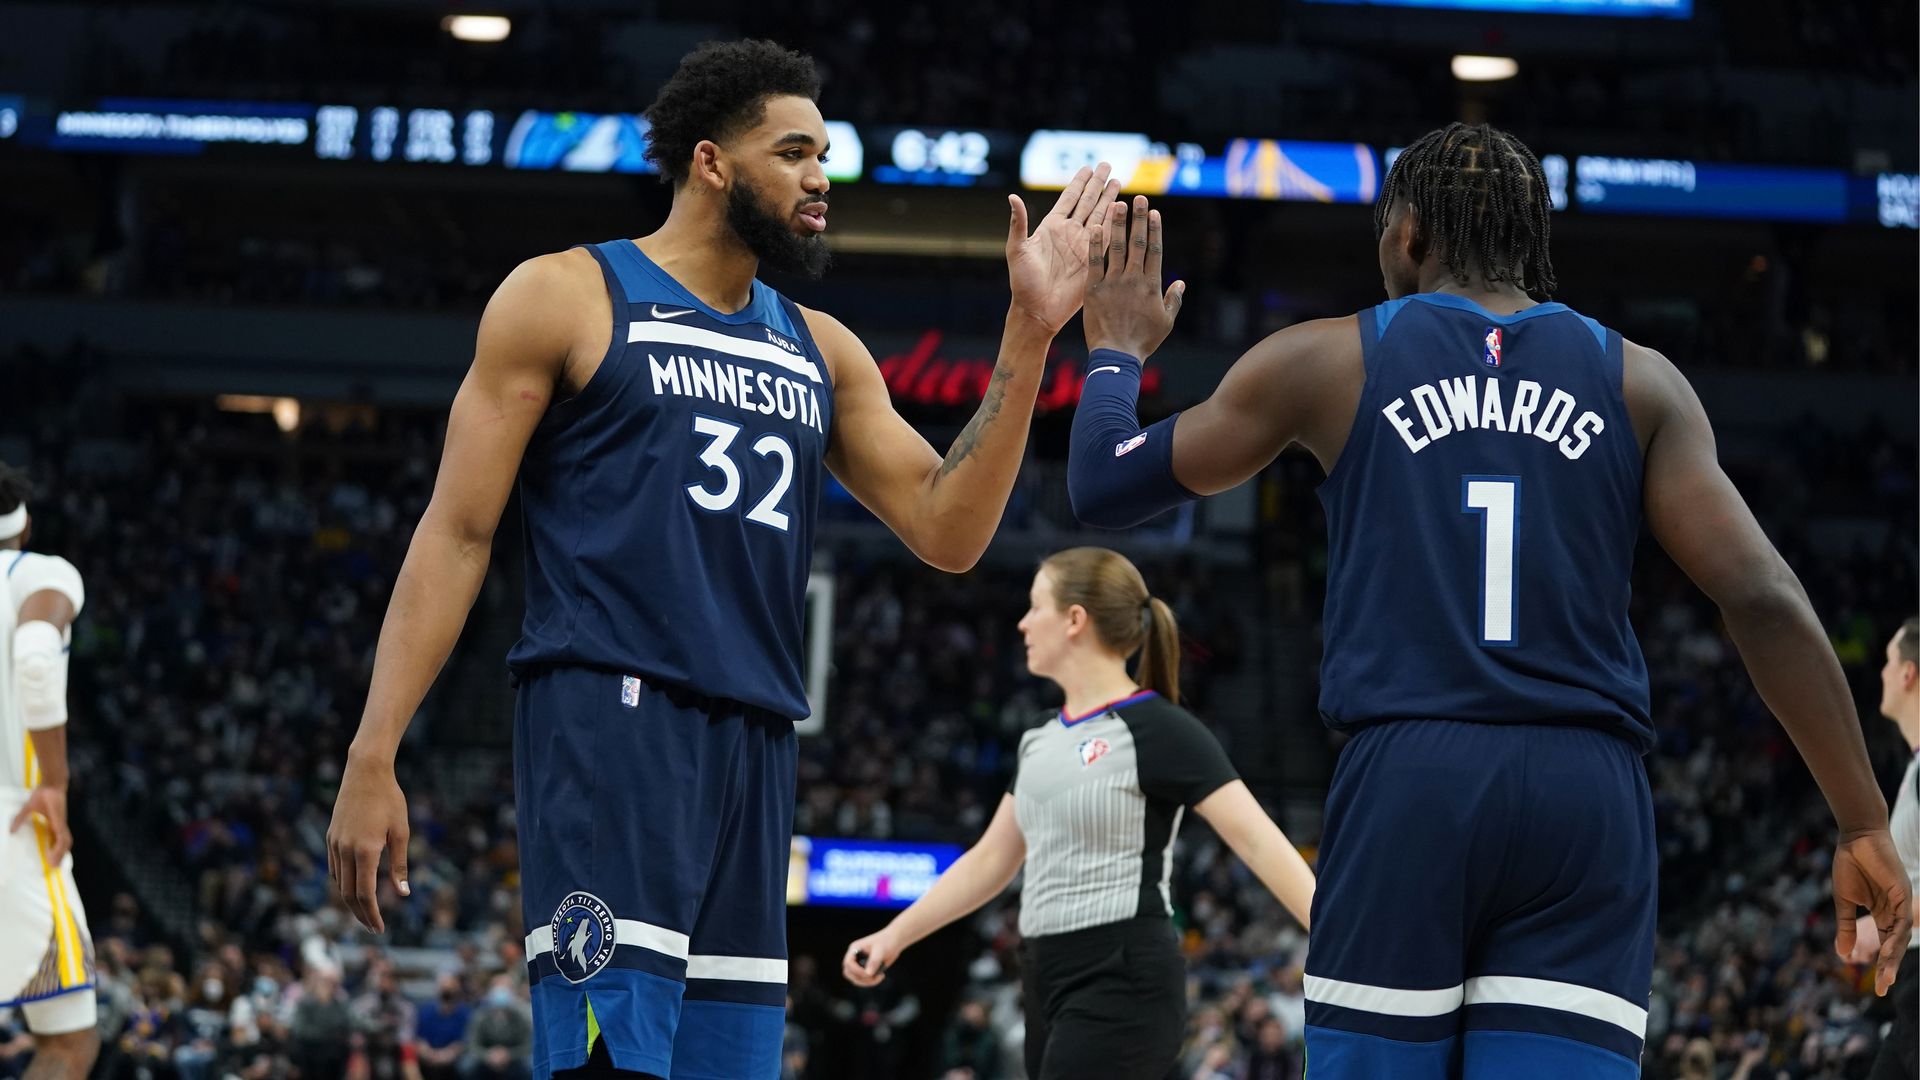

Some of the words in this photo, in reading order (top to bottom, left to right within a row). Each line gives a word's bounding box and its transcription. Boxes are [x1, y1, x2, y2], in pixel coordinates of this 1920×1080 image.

[892, 129, 990, 175] 6:42
[648, 353, 823, 434] MINNESOTA
[1382, 375, 1605, 460] EDWARDS
[685, 414, 796, 532] 32
[1464, 478, 1518, 644] 1
[578, 896, 613, 967] TIBERWOVES
